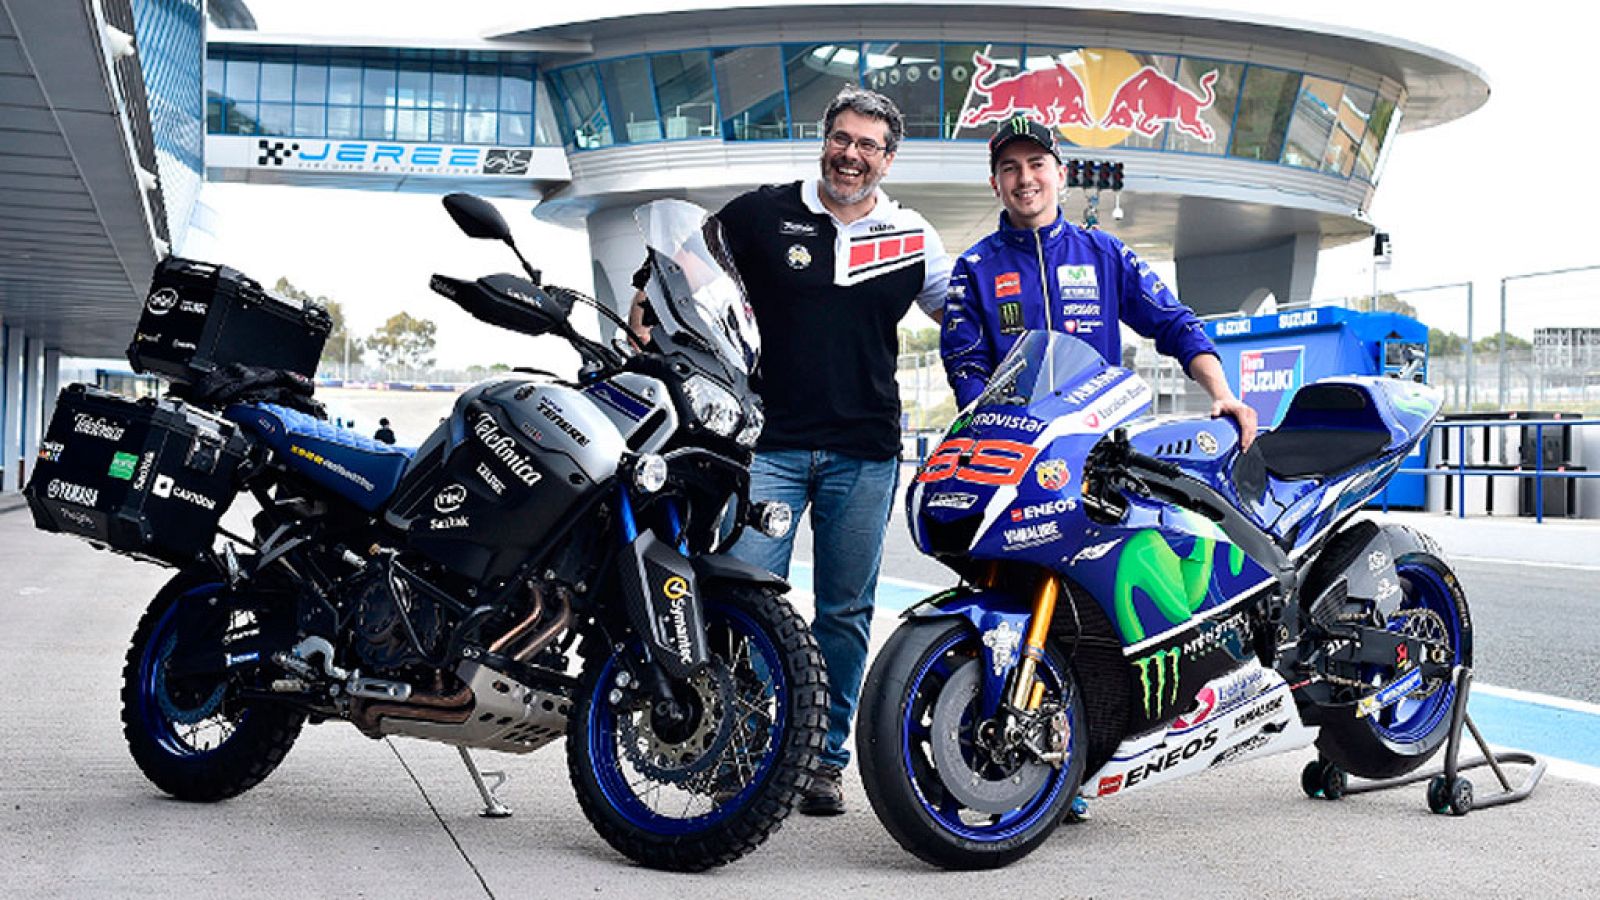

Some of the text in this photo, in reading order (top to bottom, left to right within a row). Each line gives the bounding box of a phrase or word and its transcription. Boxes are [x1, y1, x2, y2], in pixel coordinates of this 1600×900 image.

[1216, 310, 1318, 336] SUZUKI SUZUKI
[1242, 369, 1293, 393] SUZUKI
[971, 413, 1048, 433] movistar
[1023, 496, 1078, 519] ENEOS
[1124, 728, 1220, 789] ENEOS
